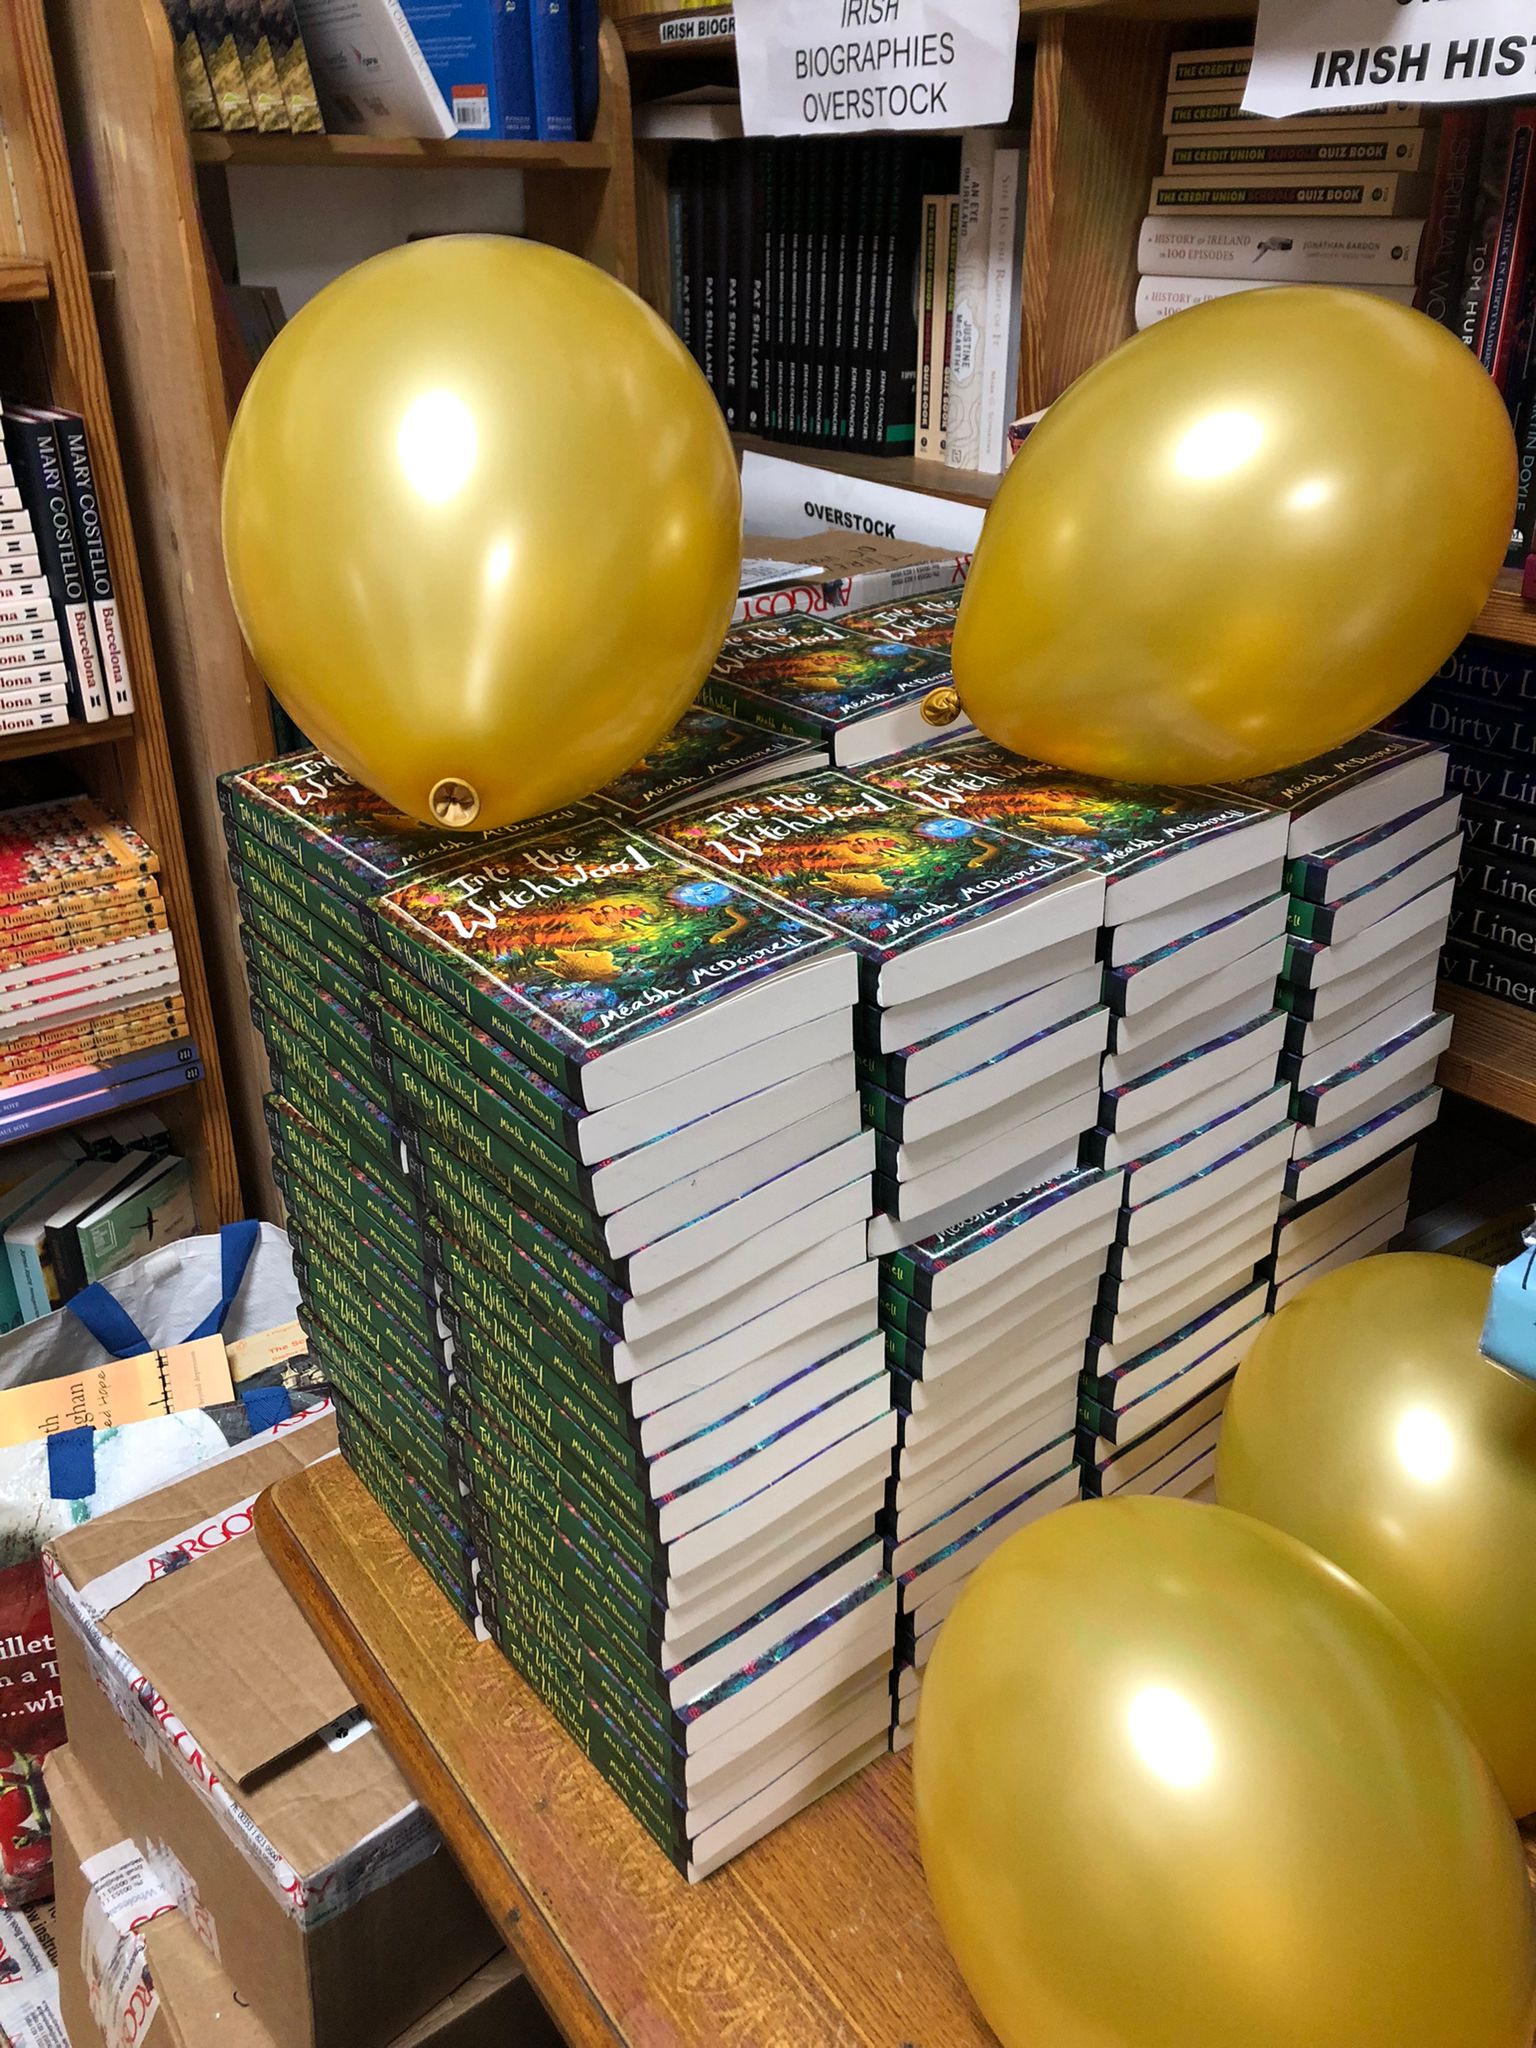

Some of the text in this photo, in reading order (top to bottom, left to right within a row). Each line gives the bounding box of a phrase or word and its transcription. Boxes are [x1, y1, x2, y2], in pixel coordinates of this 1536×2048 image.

[662, 22, 694, 41] IRISH
[840, 0, 900, 28] IRISH
[795, 32, 955, 79] BIOGRAPHIES
[1178, 64, 1195, 77] THE
[1199, 62, 1231, 75] CREDIT
[1311, 43, 1431, 88] IRISH
[803, 82, 948, 123] OVERSTOCK
[1174, 107, 1192, 121] THE
[1194, 105, 1227, 119] CREDIT
[1174, 150, 1192, 162] THE
[1194, 149, 1228, 162] CREDIT
[1230, 149, 1265, 160] UNION
[1318, 147, 1347, 159] QUIZ
[1349, 145, 1384, 158] BOOK
[961, 185, 970, 237] IRELAND
[968, 182, 980, 223] AN EYE
[1159, 192, 1176, 203] THE
[1177, 191, 1210, 202] CREDIT
[1211, 191, 1246, 202] UNION
[1297, 188, 1325, 201] QUIZ
[1327, 188, 1362, 201] BOOK
[1154, 234, 1251, 247] HISTORY IRELAND
[1167, 250, 1234, 261] 100 EPISODES
[1303, 241, 1380, 250] JONATHAN BARDON
[1501, 222, 1514, 255] MILK
[1470, 243, 1488, 291] TOM
[925, 272, 933, 310] UNION
[1151, 291, 1191, 303] HISTORY
[727, 278, 738, 386] PAT SPILLANE
[750, 280, 762, 389] PAT SPILLANE
[962, 321, 972, 368] JUSTINE
[922, 364, 930, 391] QUIZ
[862, 395, 870, 439] CONNORS
[877, 397, 885, 441] CONNORS
[921, 394, 929, 427] BOOK
[1518, 455, 1535, 511] DOYLE
[37, 436, 82, 599] MARY COSTELLO
[68, 434, 110, 595] MARY COSTELLO
[804, 501, 896, 539] OVERSTOCK
[874, 599, 958, 625] Into the
[74, 610, 96, 688] Barcelona
[102, 607, 123, 684] Barcelona
[746, 627, 791, 642] the
[1437, 654, 1509, 696] Dirty
[840, 691, 896, 714] Méabh
[1429, 703, 1501, 747] Dirty
[642, 743, 787, 801] Méabh McDonnell
[902, 750, 1004, 786] Into the
[1281, 743, 1408, 800] Méabh McDonnell
[239, 803, 251, 825] Into
[252, 810, 263, 833] the
[705, 789, 822, 834] Into the
[401, 809, 576, 867] Méabh McDonnell
[1101, 809, 1246, 865] Méabh McDonnell
[447, 843, 583, 900] Into the
[886, 857, 1057, 936] Méabh McDonnell
[600, 933, 803, 1029] Méabh McDonnell
[387, 931, 402, 957] Into
[404, 943, 418, 968] the
[521, 1038, 559, 1078] McDonnell
[15, 1069, 43, 1082] Three
[46, 1057, 83, 1073] Houses
[97, 1047, 122, 1060] Rome
[42, 1043, 79, 1059] Houses
[92, 1032, 119, 1047] Rome
[388, 978, 403, 1002] Into
[406, 990, 418, 1015] the
[518, 1089, 556, 1131] McDonnell
[429, 1147, 445, 1171] Into
[446, 1161, 459, 1186] the
[562, 1268, 600, 1310] McDonnell
[463, 1292, 477, 1314] Into
[480, 1307, 492, 1329] the
[22, 1670, 37, 1684] a
